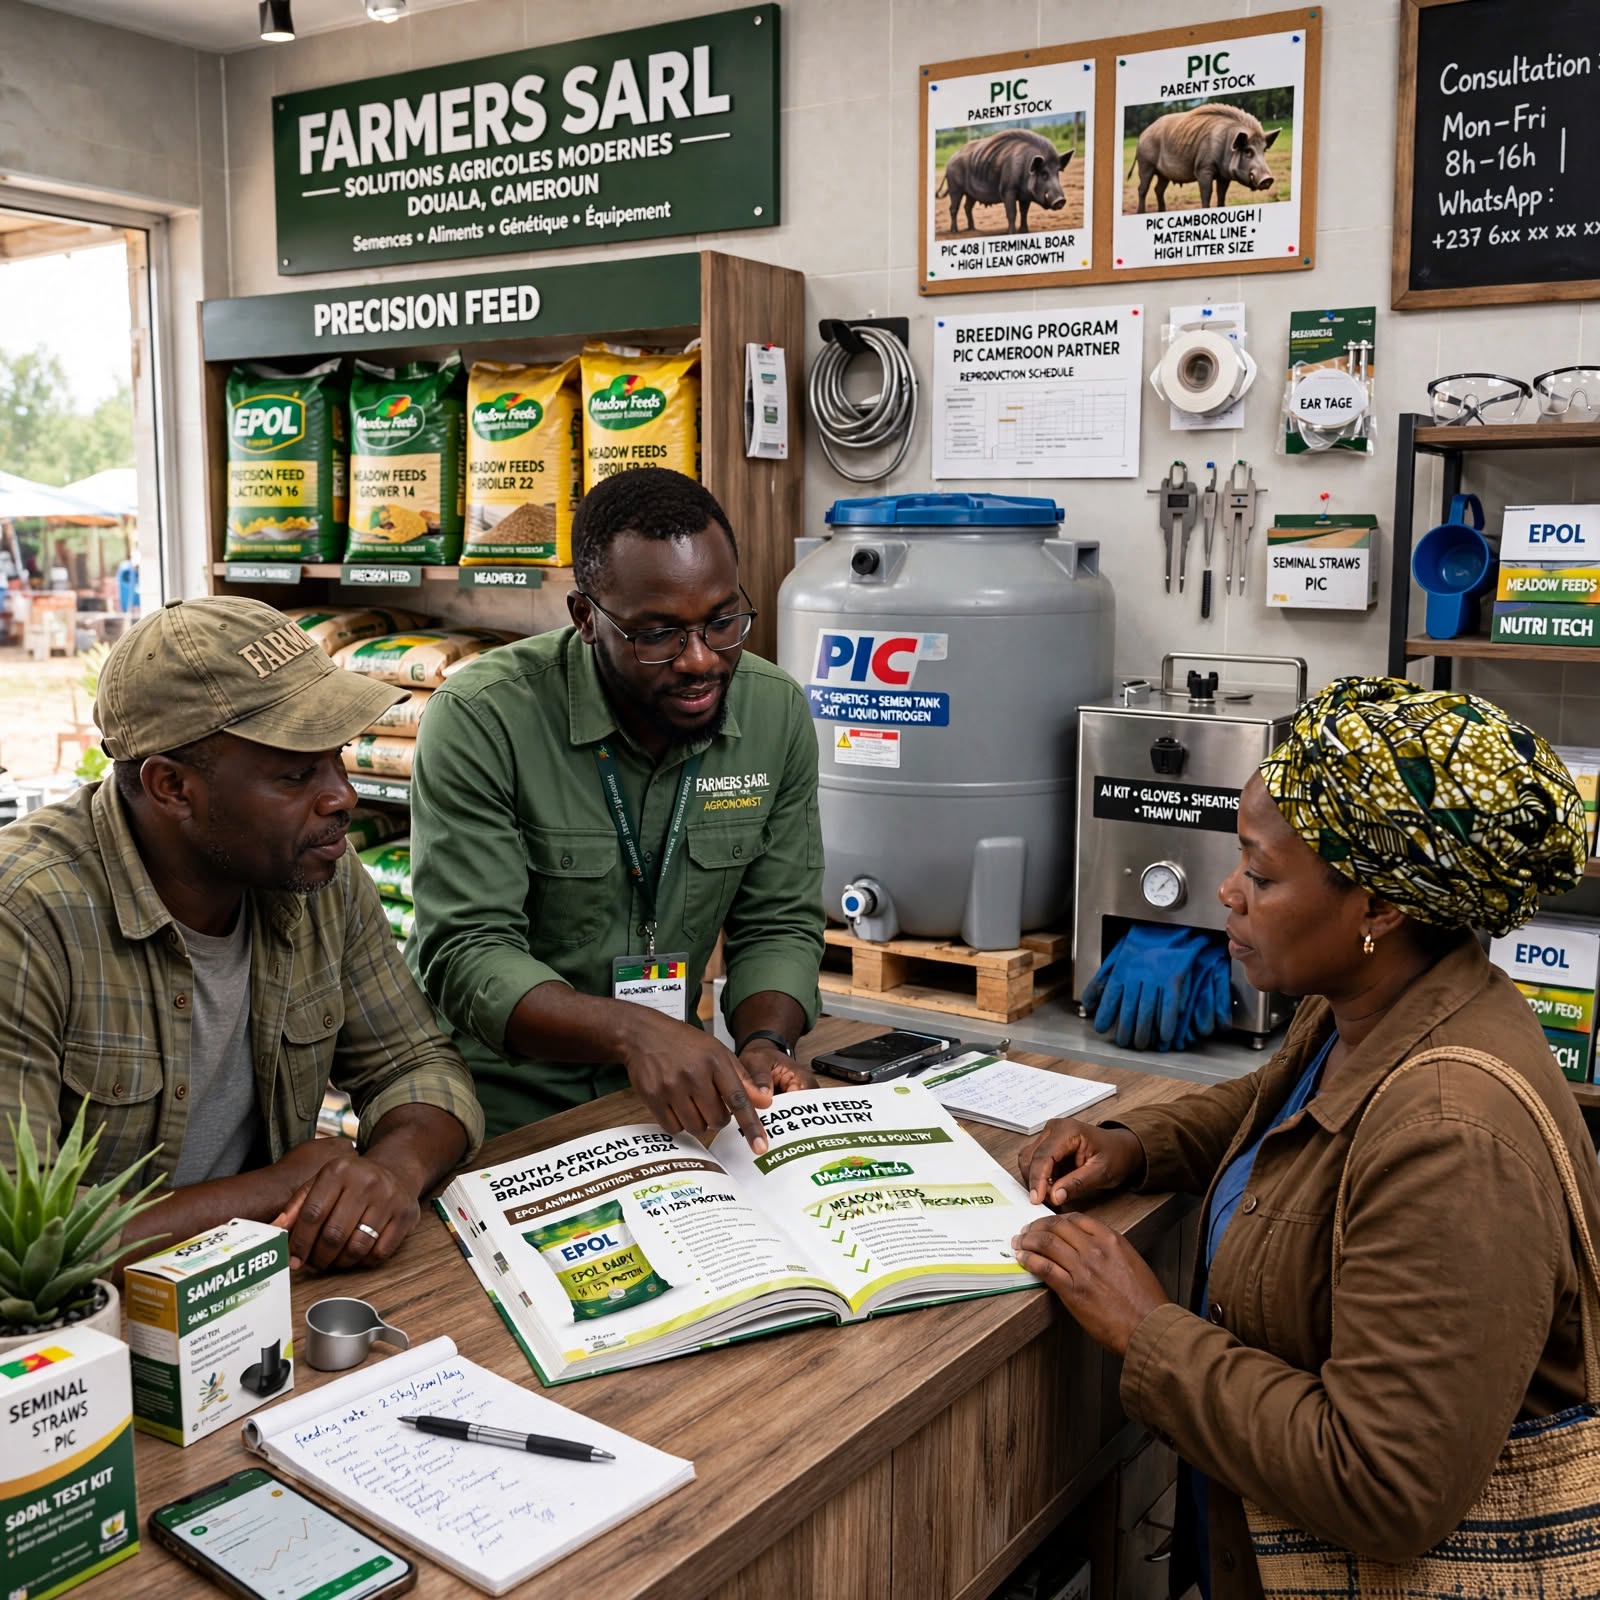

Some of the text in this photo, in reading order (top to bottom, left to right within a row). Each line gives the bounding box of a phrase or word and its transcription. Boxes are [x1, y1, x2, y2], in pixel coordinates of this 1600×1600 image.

[1187, 52, 1230, 79] PIC
[1440, 53, 1591, 95] Consultation
[990, 78, 1028, 103] PIC
[1160, 74, 1255, 98] PARENT STOCK
[298, 45, 731, 175] FARMERS SARL
[968, 99, 1052, 121] PARENT STOCK
[344, 132, 673, 198] SOLUTIONS AGRICOLES MODERNES
[408, 173, 599, 217] DOUALA, CAMEROUN
[353, 202, 671, 252] Semences Aliments Génétique Équipement
[1146, 210, 1254, 231] PIC CAMBOROUGH
[941, 235, 1075, 257] PIC 408 TERMINAL BOAR
[1154, 226, 1248, 245] MATERNAL LINE
[1432, 227, 1482, 249] +237
[1488, 225, 1520, 245] 6xx
[1154, 240, 1254, 260] HIGH LITTER SIZE
[958, 252, 1064, 271] HIGH LEAN GROWTH
[314, 284, 540, 337] PRECISION FEED
[956, 320, 1118, 344] BREEDING PROGRAM
[953, 341, 1120, 362] PIC CAMEROON PARTNER
[960, 367, 1074, 382] REPRODUCTION SCHEDULE
[631, 394, 660, 408] Feeds
[1300, 397, 1352, 409] EAR TAGE
[233, 406, 299, 437] EPOL
[508, 406, 537, 420] Feeds
[588, 445, 667, 459] MEADOW FEEDS
[276, 469, 304, 480] FEED
[393, 470, 427, 481] FEEDS
[510, 460, 545, 472] FEEDS
[286, 486, 298, 497] 16
[403, 486, 415, 496] 14
[477, 477, 534, 490] BROILER 22
[1528, 524, 1585, 544] EPOL
[1273, 557, 1360, 570] SEMINAL STRAWS
[1305, 577, 1327, 591] PIC
[1507, 578, 1597, 593] MEADOW FEEDS
[1500, 617, 1594, 637] NUTRI TECH
[816, 634, 918, 685] PIC
[810, 689, 823, 702] PIC
[879, 695, 912, 707] SEMEN
[913, 696, 940, 709] TANK
[848, 707, 878, 720] LIQUID
[880, 710, 931, 722] NITROGEN
[696, 773, 770, 792] FARMERS SARL
[704, 796, 762, 811] AGRONOMIST
[1100, 784, 1240, 810] AI KIT GLOVES SHEATHS
[1142, 805, 1202, 823] THAW UNIT
[1515, 943, 1569, 968] EPOL
[822, 1100, 873, 1112] FEEDS
[766, 1112, 873, 1139] IG & POULTRY
[765, 1142, 816, 1166] MEADOW
[817, 1138, 851, 1149] FEEDS
[858, 1135, 877, 1144] PIG
[889, 1132, 932, 1141] POULTRY
[490, 1133, 673, 1192] SOUTH AFRICAN FEED
[494, 1143, 679, 1202] BRANDS CATALOG 2024
[515, 1206, 544, 1220] EPOL
[585, 1172, 634, 1195] NUTRITION
[640, 1164, 671, 1177] DAIRY
[673, 1161, 704, 1170] FEEDS
[829, 1191, 883, 1211] MEADOW
[646, 1207, 660, 1217] 16
[691, 1194, 736, 1204] PROTEIN
[561, 1233, 618, 1261] EPOL
[248, 1250, 278, 1275] FEED
[9, 1378, 88, 1424] SEMINAL
[32, 1400, 88, 1438] STRAWS
[54, 1429, 77, 1452] PIC
[294, 1425, 342, 1448] feeding
[52, 1466, 113, 1508] TEST KIT
